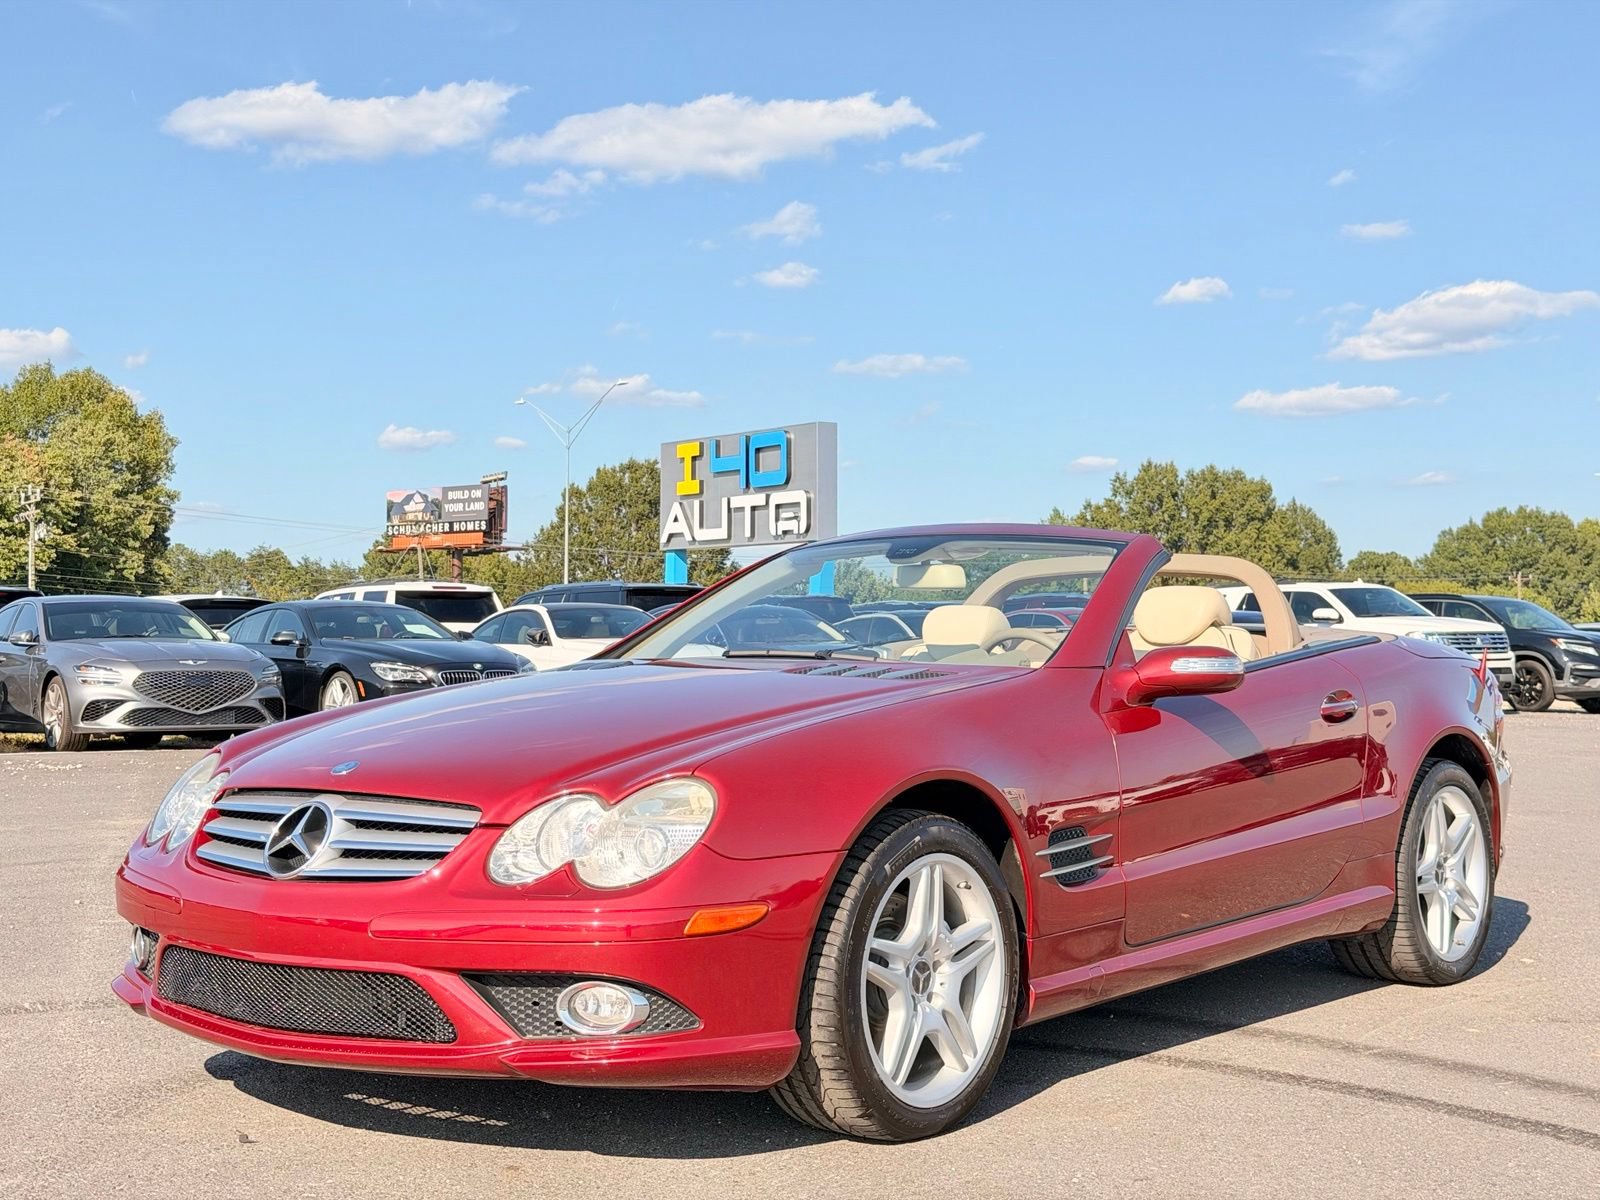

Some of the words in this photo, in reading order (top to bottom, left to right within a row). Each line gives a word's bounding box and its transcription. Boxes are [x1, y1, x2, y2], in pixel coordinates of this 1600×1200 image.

[448, 489, 469, 500] BUILD
[471, 489, 482, 499] ON
[444, 502, 464, 512] YOUR
[465, 501, 485, 511] LAND
[453, 520, 487, 532] HOMES
